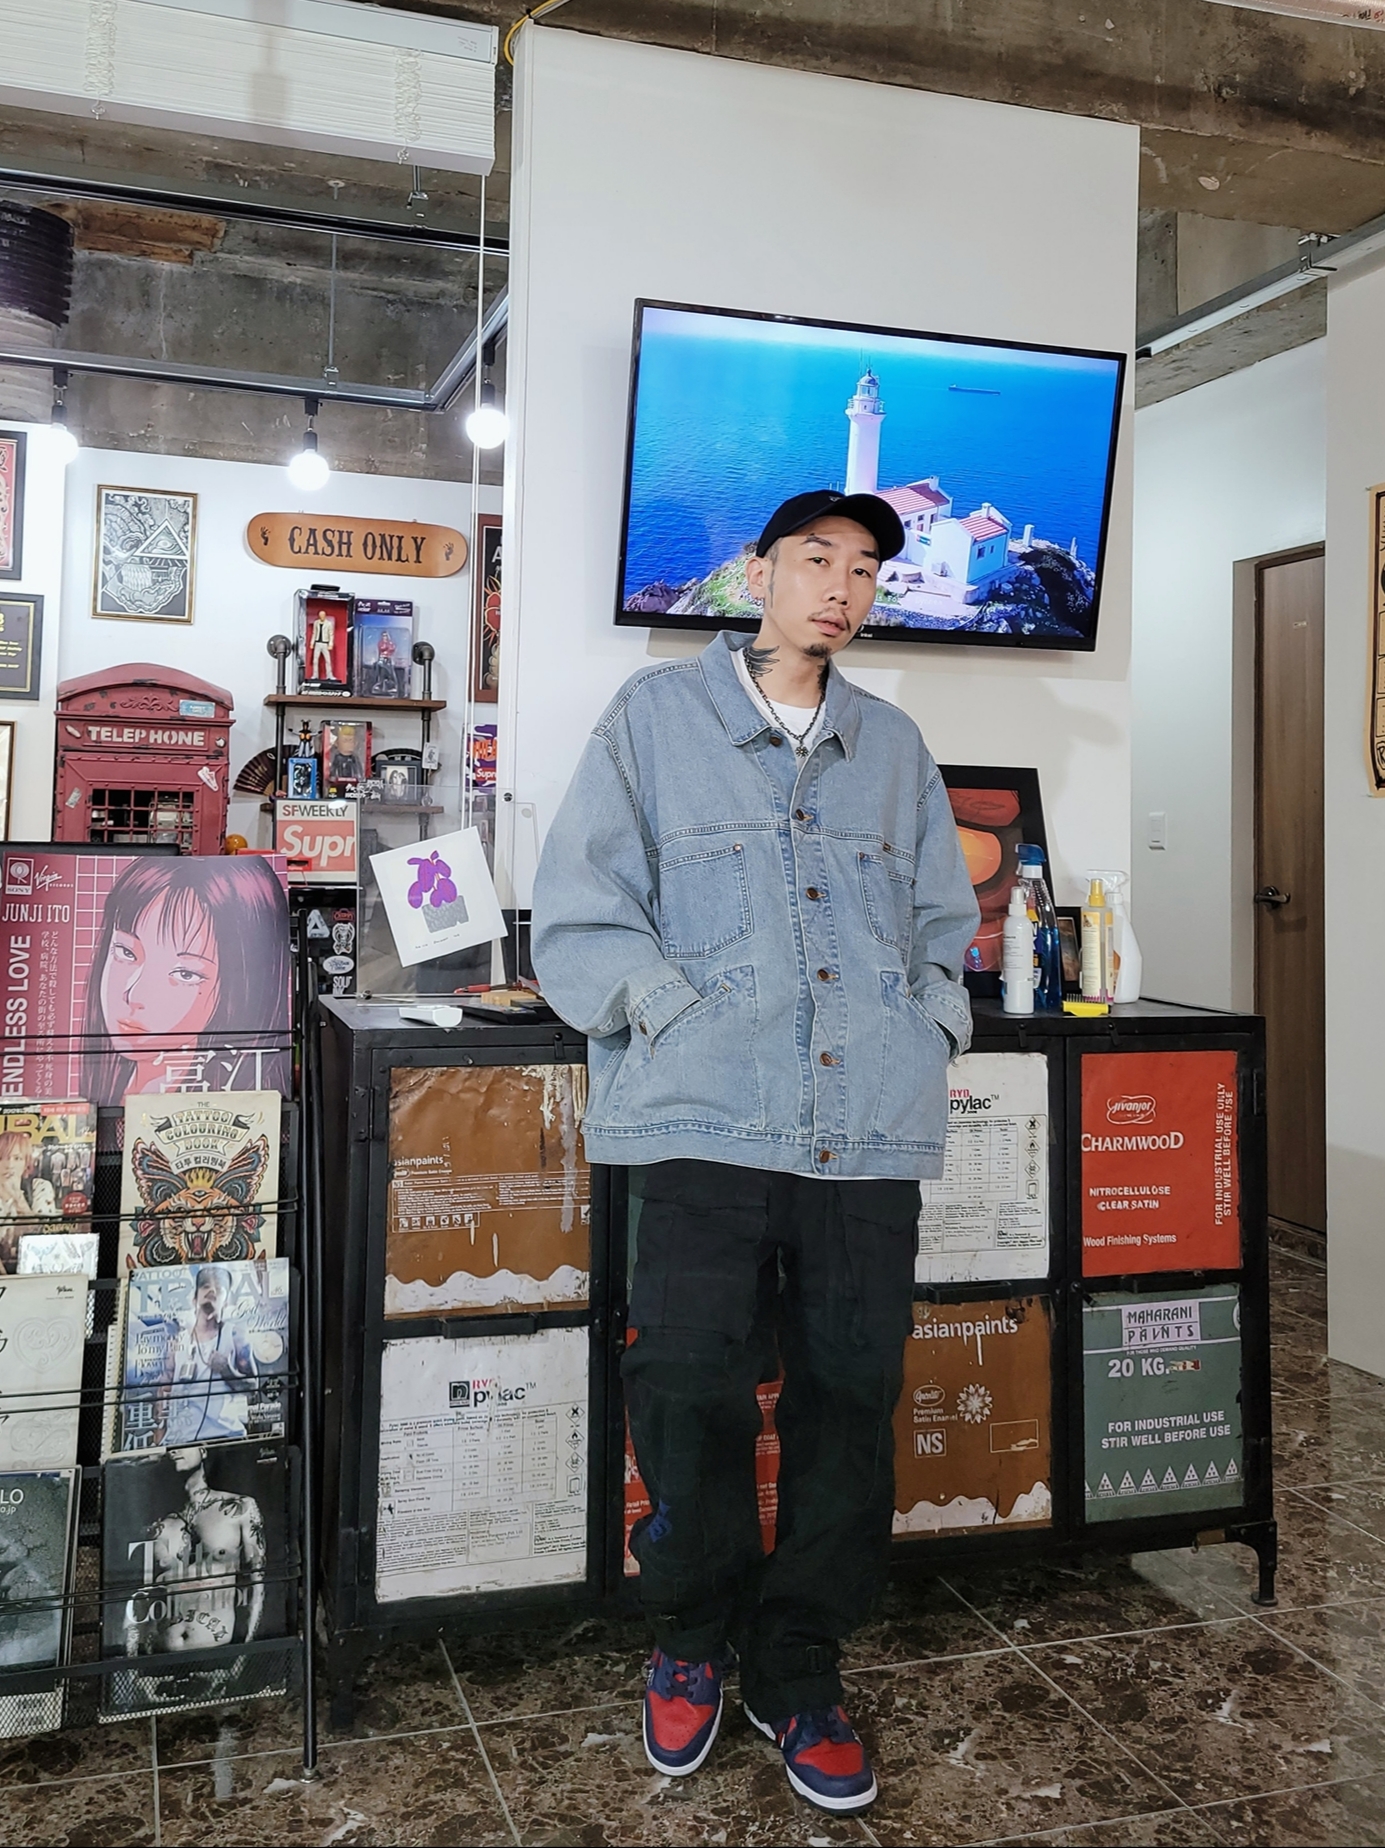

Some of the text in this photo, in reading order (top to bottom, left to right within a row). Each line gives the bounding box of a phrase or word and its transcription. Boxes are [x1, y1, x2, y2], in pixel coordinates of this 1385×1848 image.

[288, 526, 427, 563] CASH ONLY
[87, 725, 206, 747] TELEPHONE
[2, 903, 70, 923] JUNJI ITO
[8, 935, 31, 991] LOVE
[2, 996, 28, 1097] ENDLESS
[176, 1110, 229, 1123] TATTOO
[1215, 1112, 1225, 1133] USE
[165, 1123, 239, 1140] COLOURING
[1081, 1131, 1184, 1152] CHARMWOOD
[185, 1137, 218, 1150] BOOK
[1222, 1091, 1233, 1216] STIR WELL BEFORE USE
[1214, 1136, 1224, 1201] INDUSTRIAL
[1089, 1186, 1171, 1197] NITROCELLULOSE
[1097, 1199, 1159, 1211] CLEAR SATIN
[1215, 1203, 1223, 1225] FOR
[1083, 1233, 1177, 1247] Wood Finishing Systems
[1127, 1306, 1192, 1324] MAHARANI
[912, 1315, 1018, 1341] asianpaints
[1128, 1325, 1194, 1343] PAINTS
[1108, 1358, 1135, 1377] 20
[913, 1407, 944, 1416] Premium
[913, 1415, 932, 1423] Satin
[1108, 1411, 1225, 1434] FOR INDUSTRIAL USE
[917, 1432, 944, 1455] NS
[1101, 1425, 1231, 1449] STIR WELL BEFORE USE
